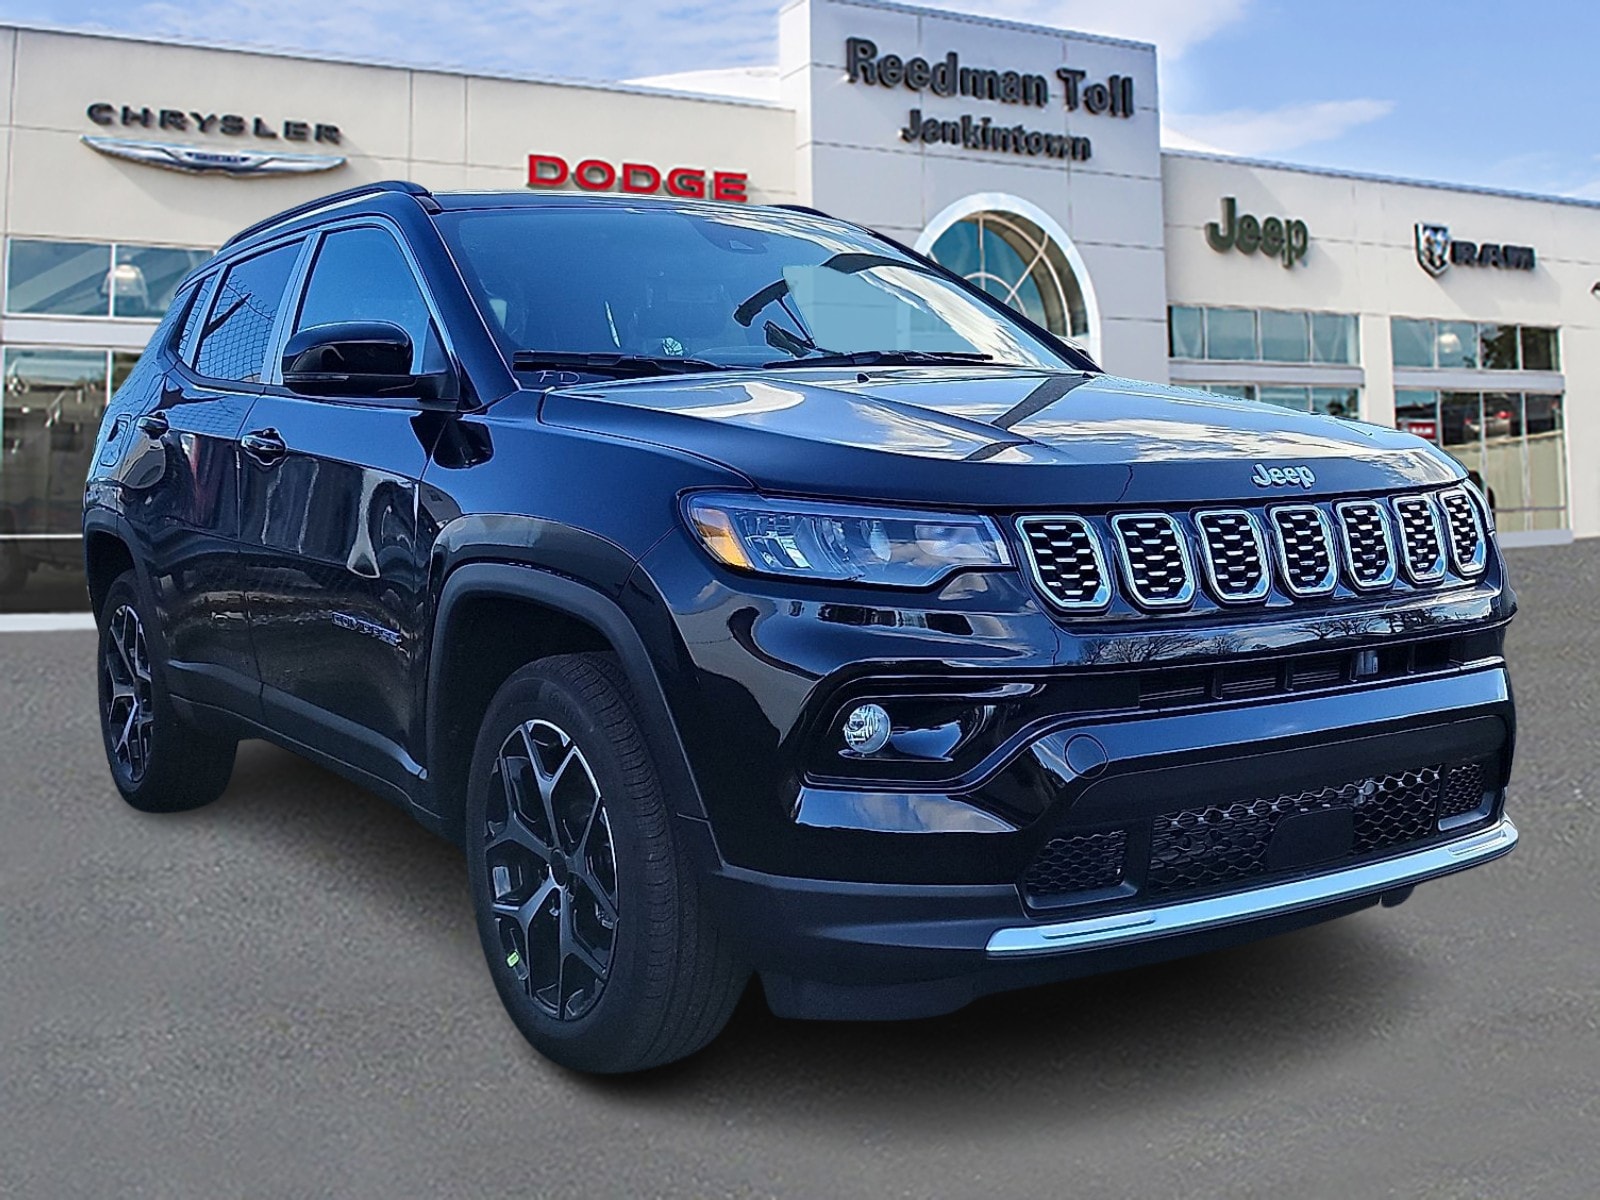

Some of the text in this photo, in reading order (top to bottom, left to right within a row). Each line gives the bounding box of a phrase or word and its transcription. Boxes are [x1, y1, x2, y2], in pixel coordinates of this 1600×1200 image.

[846, 37, 1134, 118] Reedman Toll
[87, 102, 341, 145] CHRYSLER
[901, 109, 1091, 161] Jenkintown
[528, 154, 748, 202] DODGE
[1204, 196, 1308, 269] Jeep
[1450, 240, 1536, 270] RAM
[1251, 463, 1316, 490] Jeep
